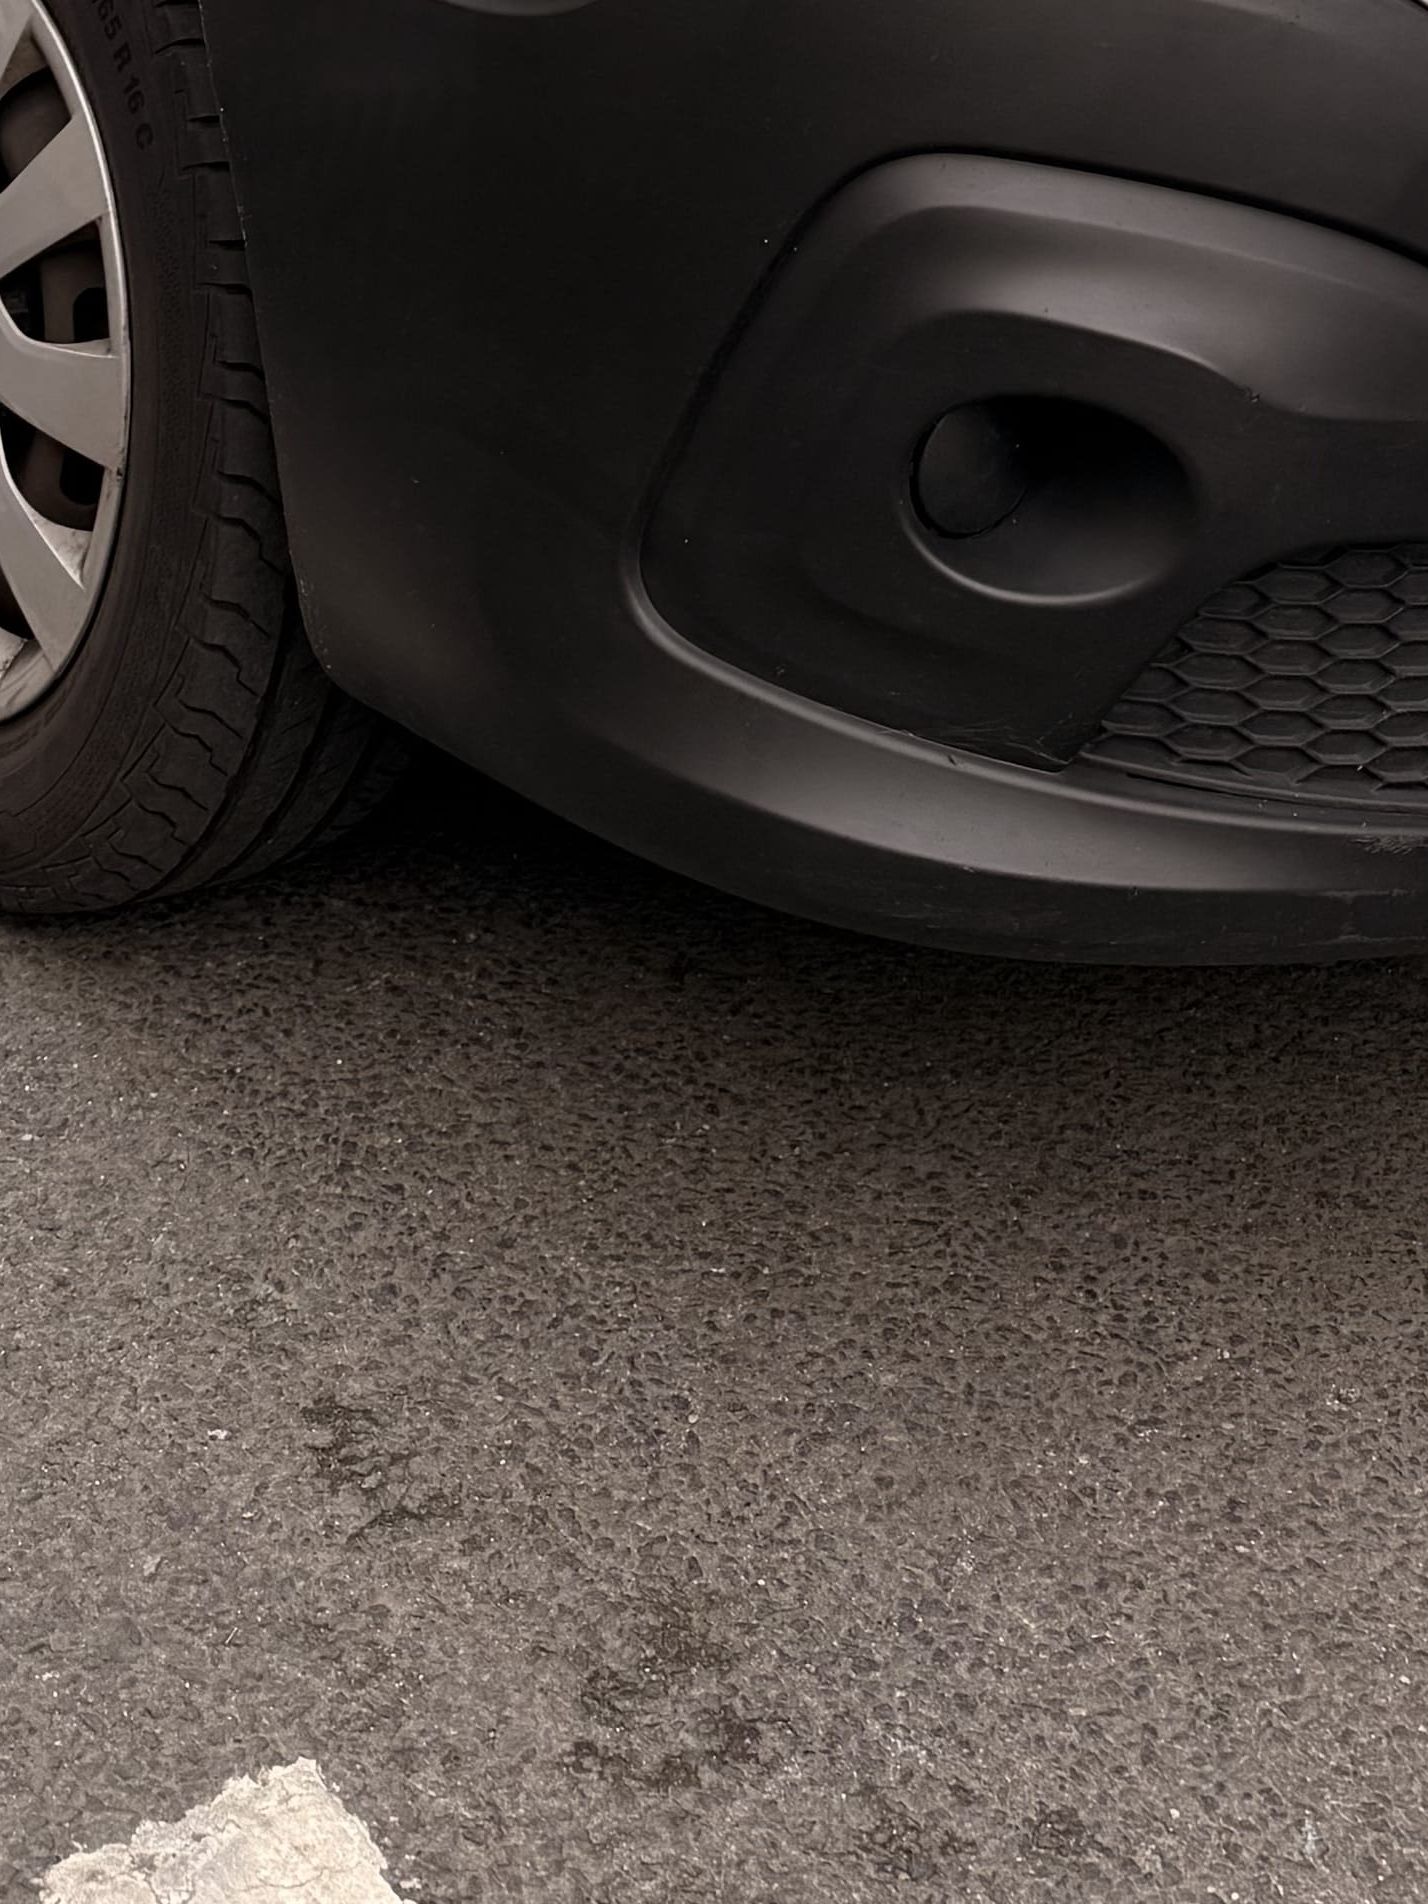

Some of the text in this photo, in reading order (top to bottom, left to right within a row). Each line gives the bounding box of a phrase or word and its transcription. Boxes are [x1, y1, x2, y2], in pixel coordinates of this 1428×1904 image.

[112, 42, 132, 74] R
[122, 74, 145, 114] 16
[134, 122, 154, 152] C
